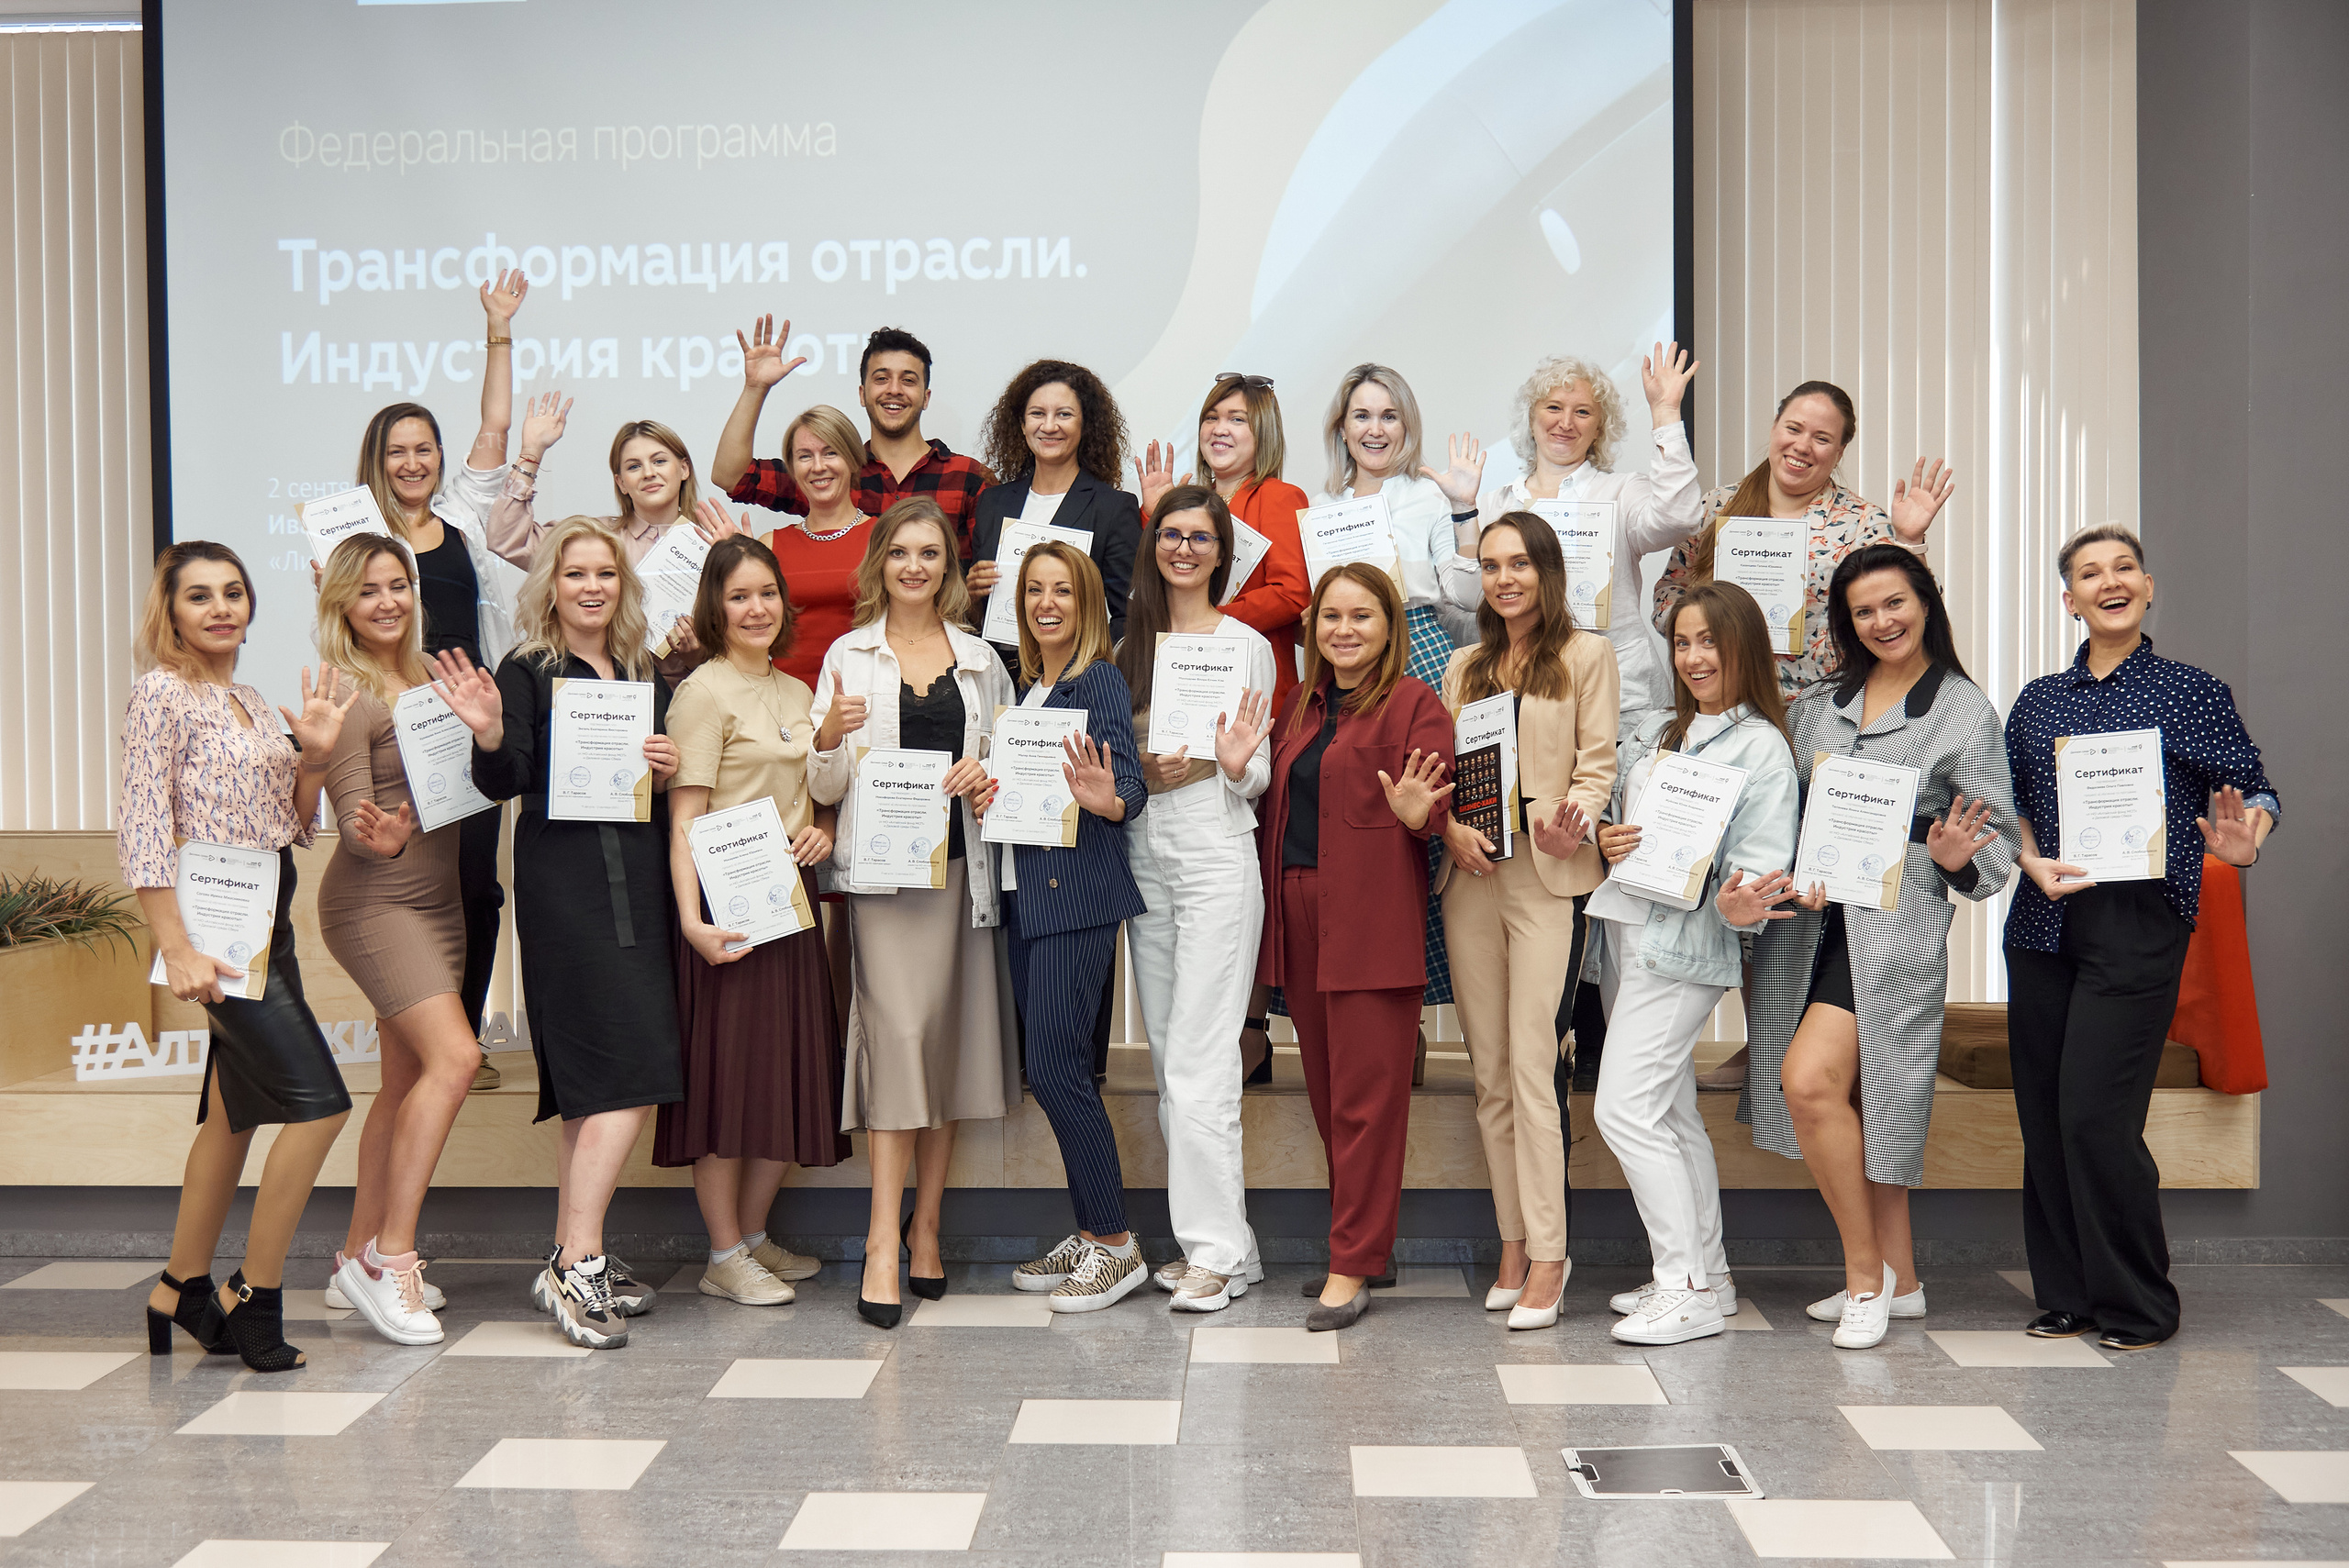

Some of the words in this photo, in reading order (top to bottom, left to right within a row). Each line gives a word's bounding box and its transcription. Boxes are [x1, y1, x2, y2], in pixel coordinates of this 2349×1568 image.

[279, 119, 579, 175] Федеральная
[593, 121, 838, 170] программа
[278, 231, 790, 306] Трансформация
[811, 237, 1088, 295] отрасли.
[281, 330, 619, 395] Индусрия
[320, 517, 370, 536] Сертификат
[1317, 519, 1375, 538] Сертификат
[1555, 529, 1599, 538] тификат
[670, 546, 703, 574] Сертифи
[1731, 548, 1793, 559] Сертификат
[1171, 662, 1234, 673] Сертификат
[410, 710, 456, 731] Сертифик
[570, 710, 637, 721] Сертификат
[1008, 738, 1063, 748] Сертифика
[1465, 726, 1506, 745] Сертификат
[2075, 766, 2143, 779] Сертификат
[873, 779, 936, 791] Сертификат
[1660, 782, 1720, 805] Сертификат
[1827, 787, 1896, 806] Сертификат
[708, 830, 768, 855] Сертификат
[190, 873, 261, 891] Сертификат
